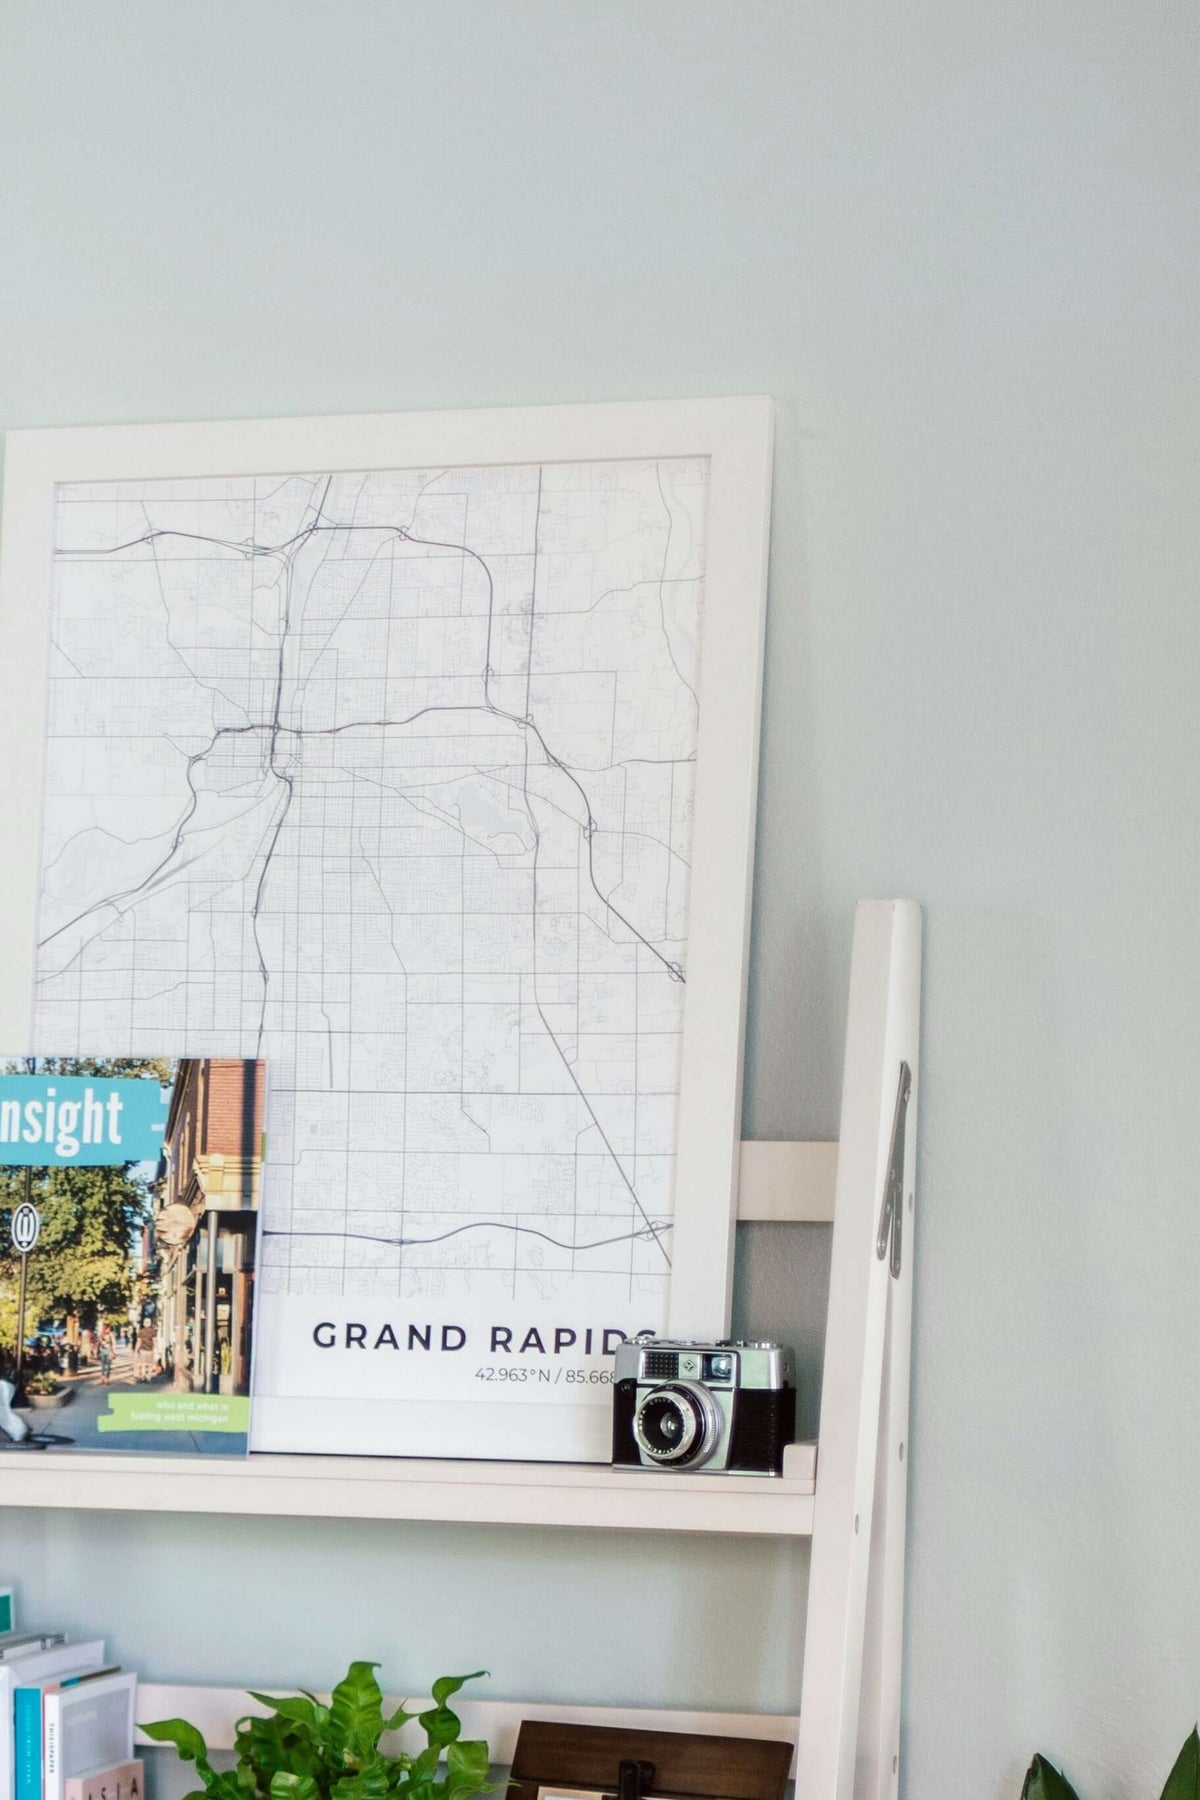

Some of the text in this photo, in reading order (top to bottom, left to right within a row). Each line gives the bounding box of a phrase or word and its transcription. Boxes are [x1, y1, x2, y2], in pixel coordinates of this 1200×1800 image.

[313, 1322, 656, 1355] GRAND RAPID
[475, 1367, 551, 1383] 42.963°N
